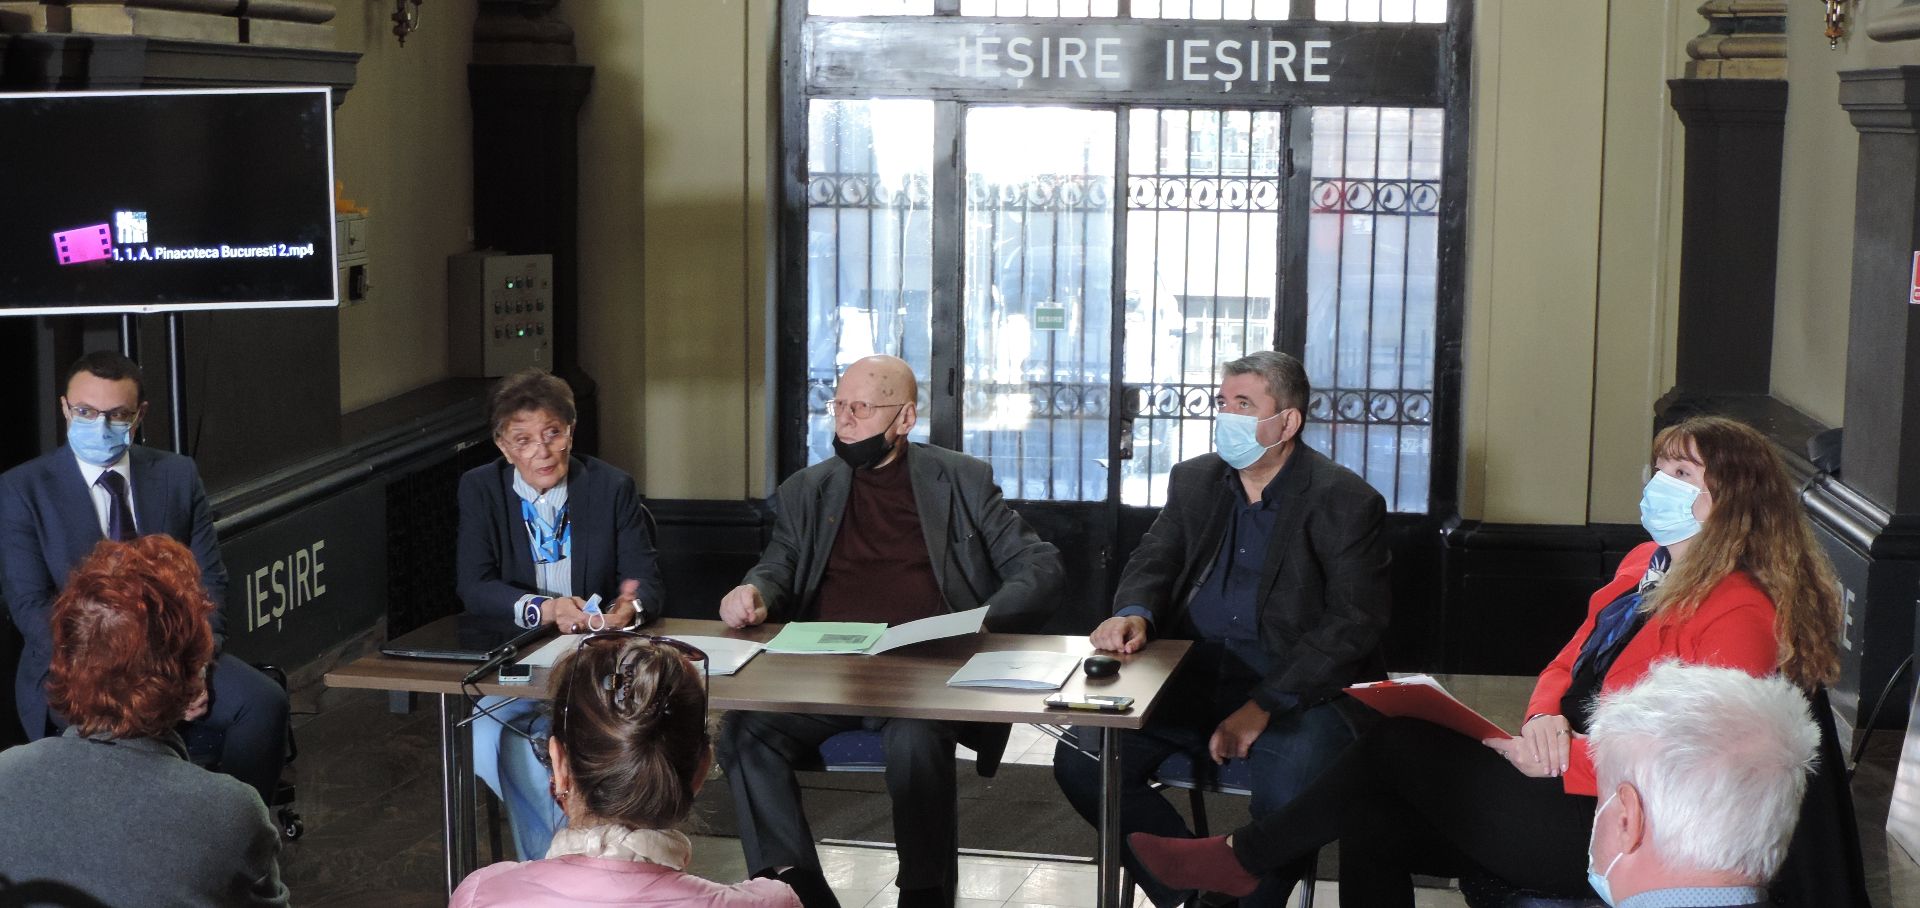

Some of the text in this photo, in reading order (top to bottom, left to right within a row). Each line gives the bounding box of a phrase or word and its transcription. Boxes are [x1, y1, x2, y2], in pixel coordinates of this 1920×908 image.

[959, 36, 1332, 92] IEȘIRE IEȘIRE
[155, 246, 219, 260] Pinacoteca
[221, 244, 277, 258] Bucuresti
[278, 243, 315, 258] 2.mp4
[246, 540, 327, 633] IEȘIRE
